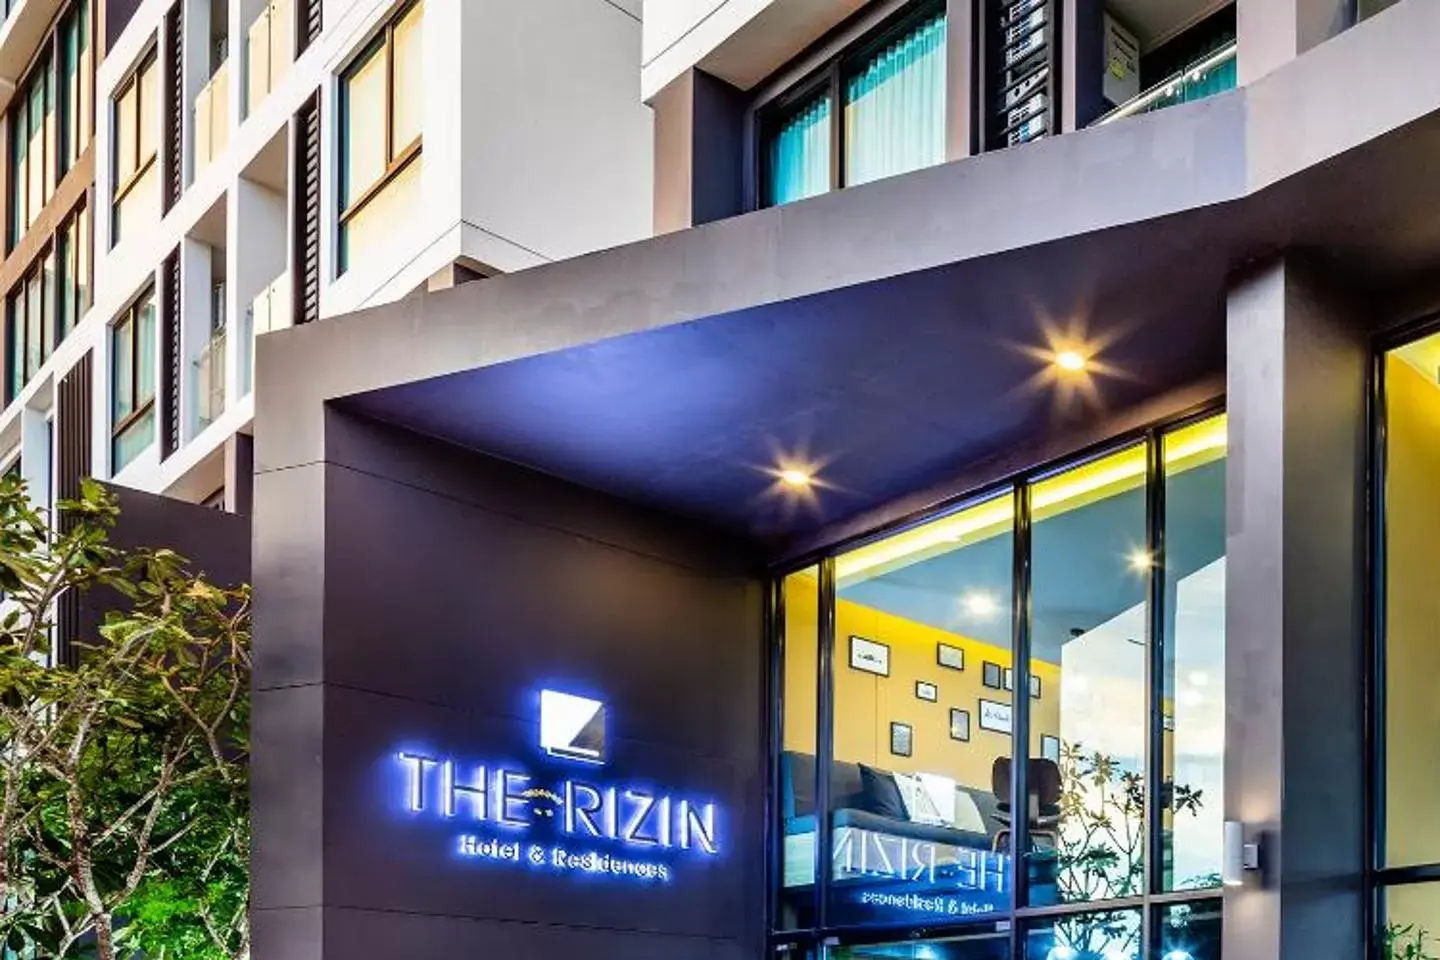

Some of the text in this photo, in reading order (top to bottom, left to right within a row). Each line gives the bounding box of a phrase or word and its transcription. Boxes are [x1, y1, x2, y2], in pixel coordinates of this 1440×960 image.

[398, 751, 717, 854] THE RIZIN
[459, 835, 670, 882] Hotel & Residences
